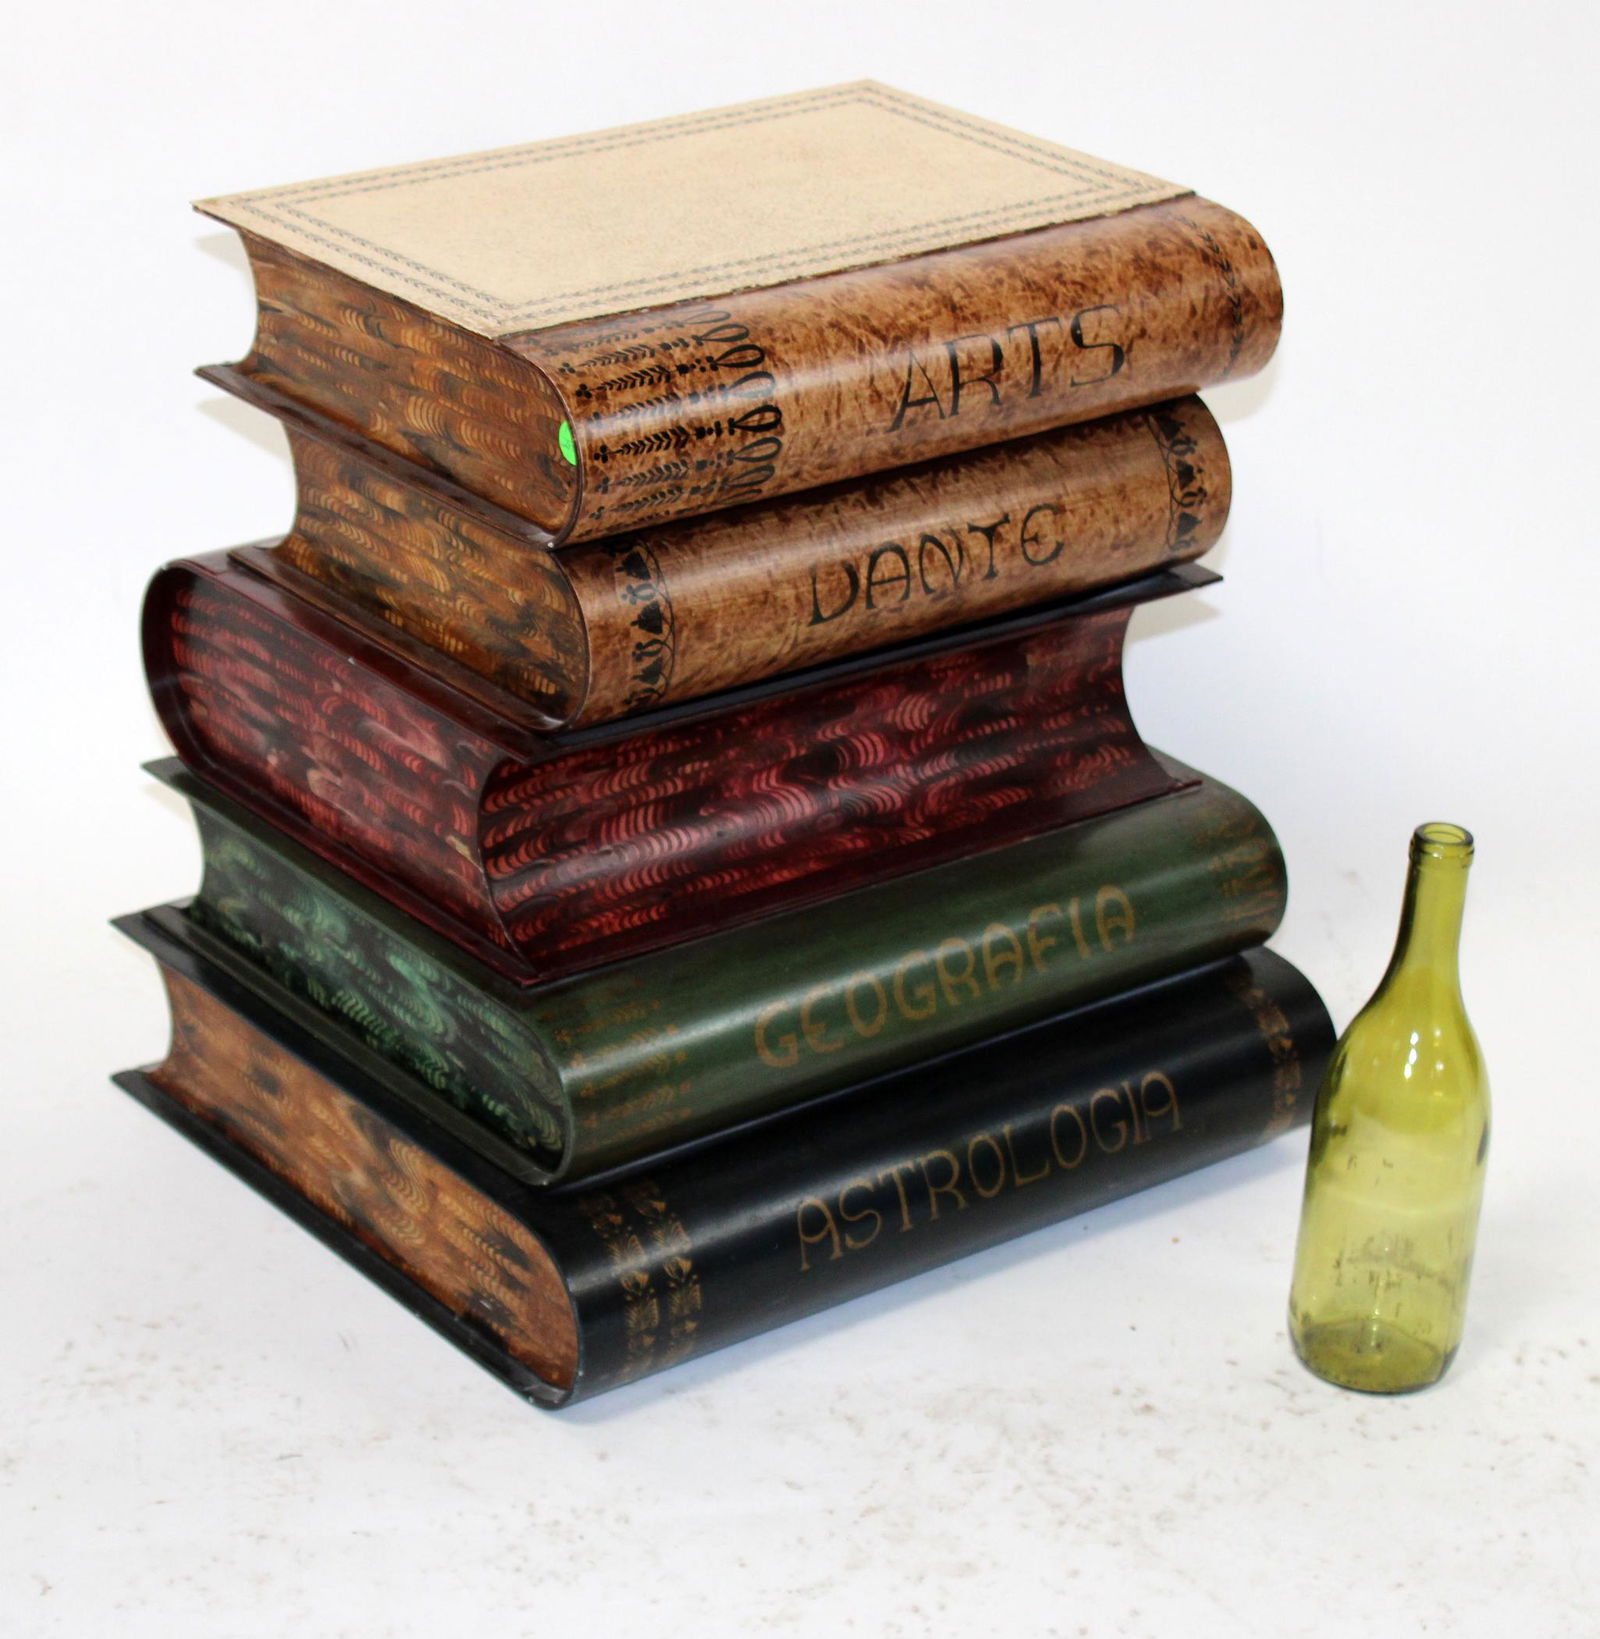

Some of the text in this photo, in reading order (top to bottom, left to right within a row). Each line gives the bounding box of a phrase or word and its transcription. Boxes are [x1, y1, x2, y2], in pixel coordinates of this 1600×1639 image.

[886, 304, 1125, 432] ARTS
[807, 503, 1064, 626] DANTE
[754, 885, 1136, 1068] GEOGRAFIA
[796, 1071, 1182, 1271] ASTROLOGIA
